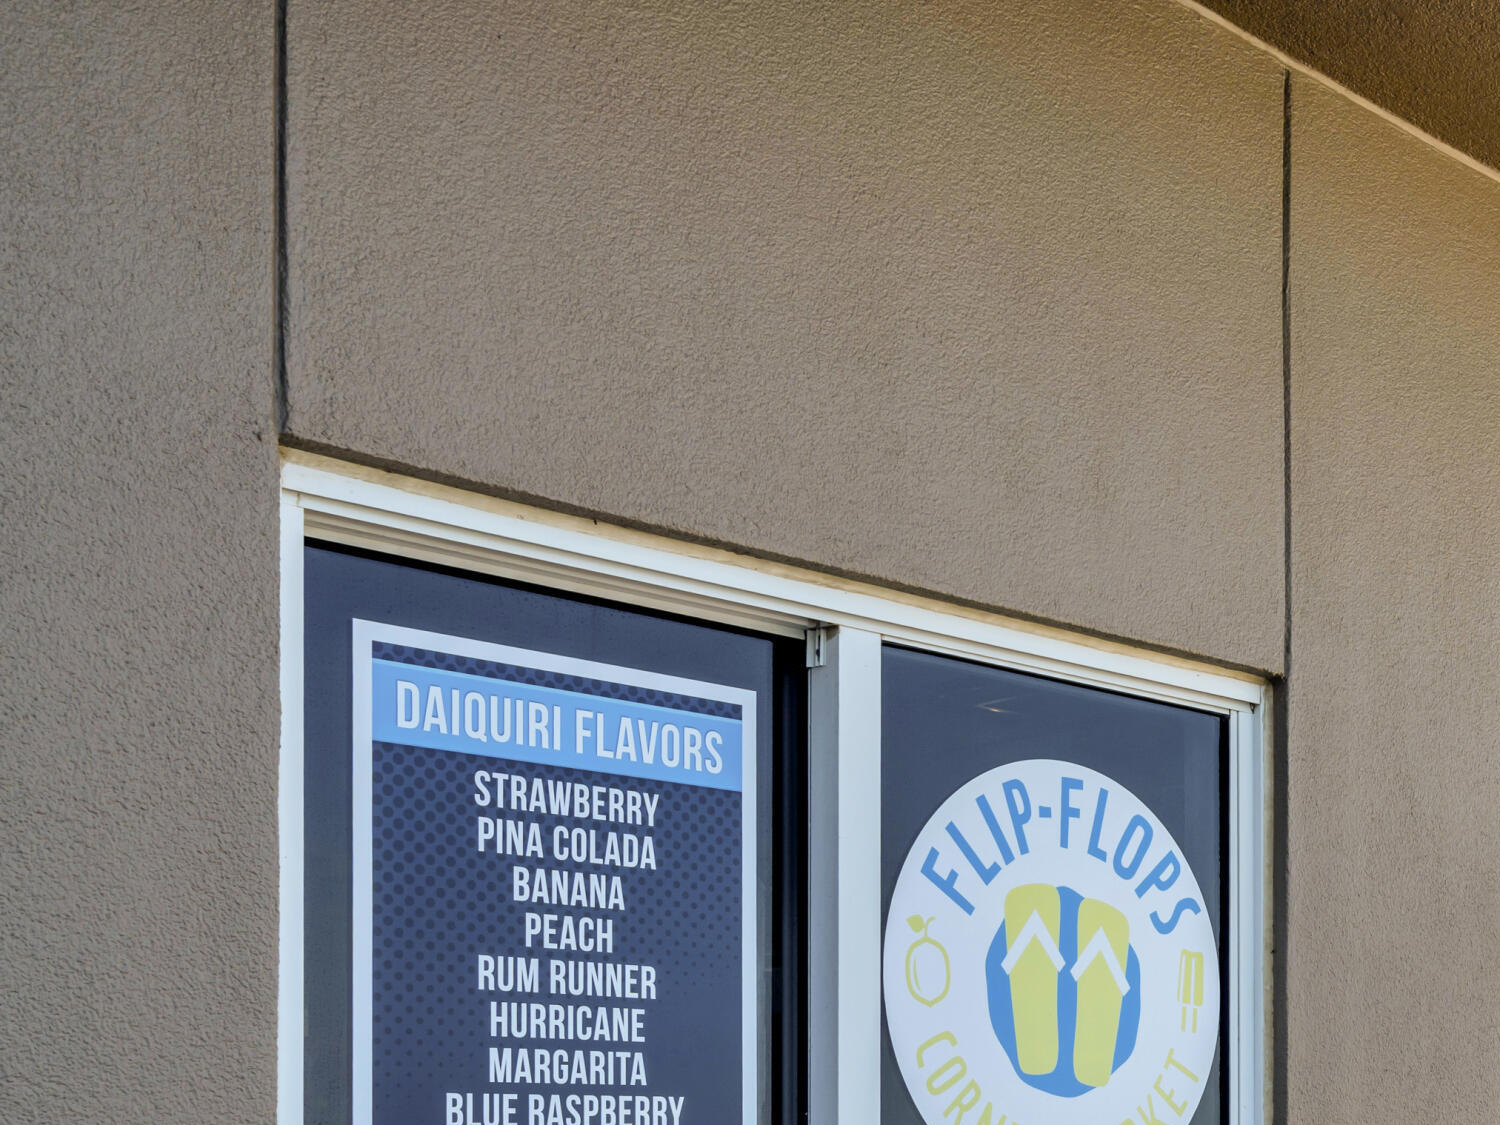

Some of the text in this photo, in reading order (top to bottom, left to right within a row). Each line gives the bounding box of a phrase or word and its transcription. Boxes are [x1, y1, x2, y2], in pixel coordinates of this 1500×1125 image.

[396, 680, 724, 774] DAIQUIRI FLAVORS
[473, 770, 659, 827] STRAWBERRY
[477, 816, 657, 870] PINA COLADA
[920, 776, 1201, 935] FLIP-FLOPS
[512, 866, 625, 911] BANANA
[525, 912, 614, 953] PEACH
[477, 955, 657, 1000] RUM RUNNER
[489, 1001, 646, 1043] HURRICANE
[488, 1047, 647, 1086] MARGARITA
